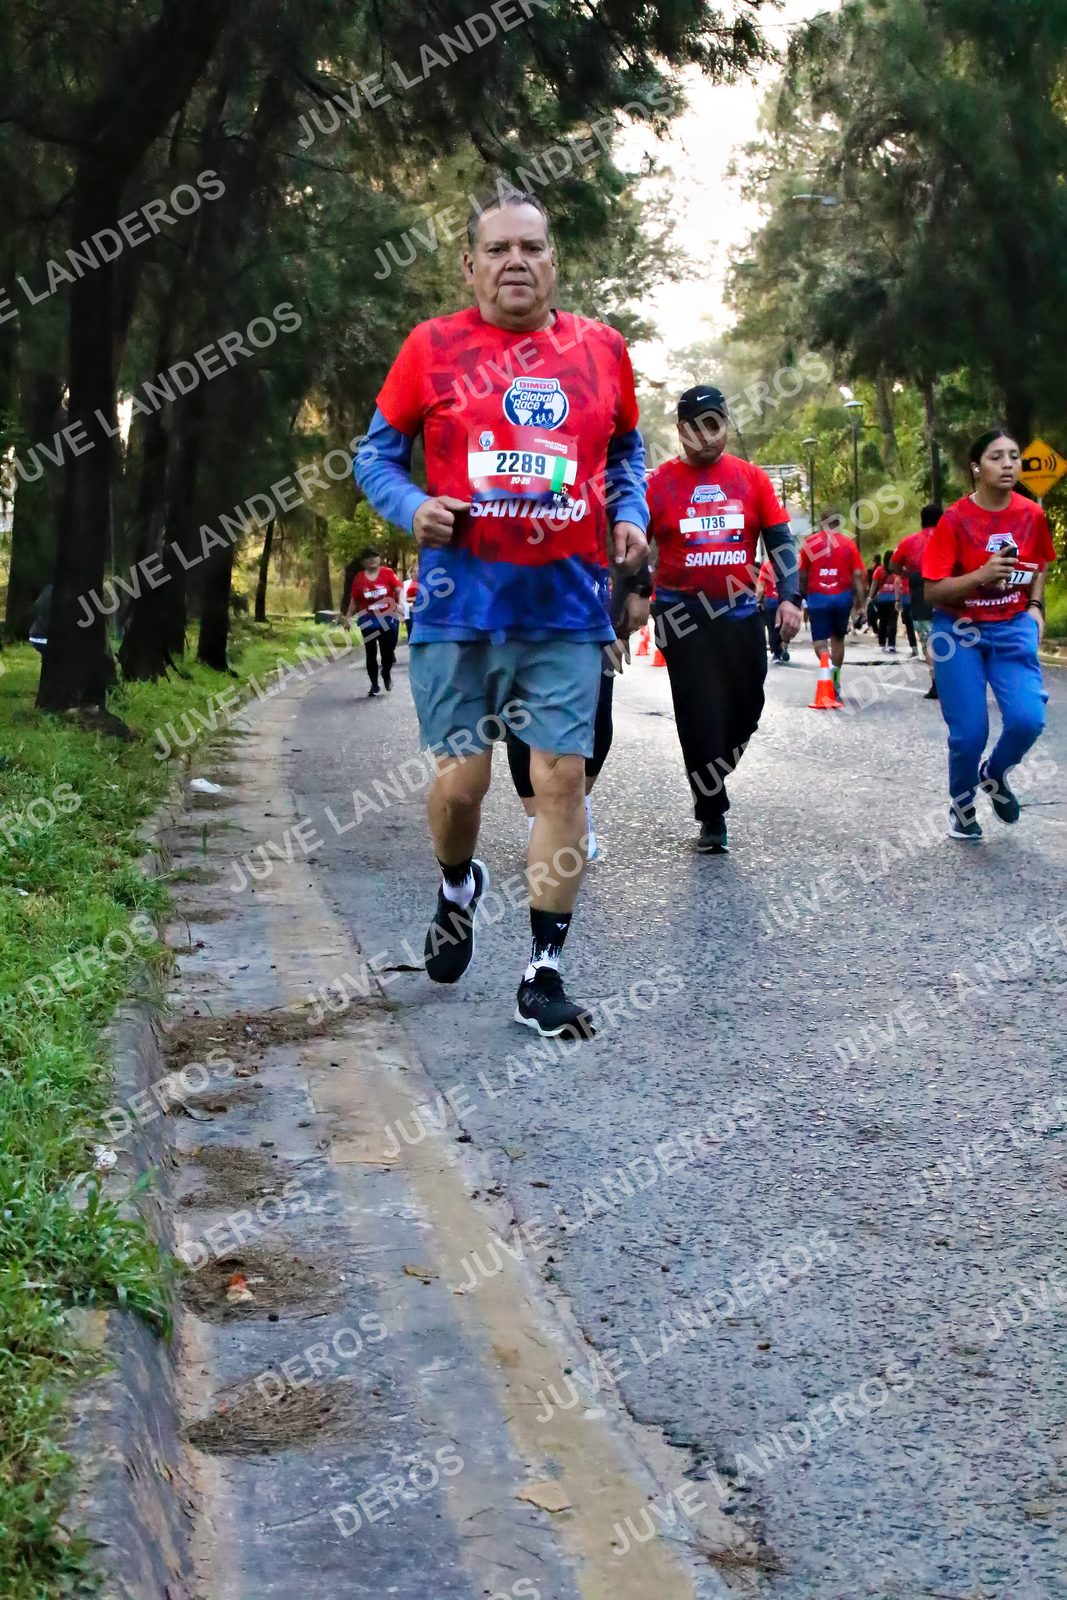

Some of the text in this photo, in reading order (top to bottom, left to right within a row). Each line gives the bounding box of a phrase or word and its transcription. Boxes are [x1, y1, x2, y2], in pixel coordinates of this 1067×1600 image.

[519, 381, 554, 390] BIMBO
[520, 391, 554, 403] Global
[513, 399, 540, 410] Race
[496, 452, 546, 475] 2289
[701, 516, 725, 530] 1736
[685, 550, 747, 567] SANTIAGO
